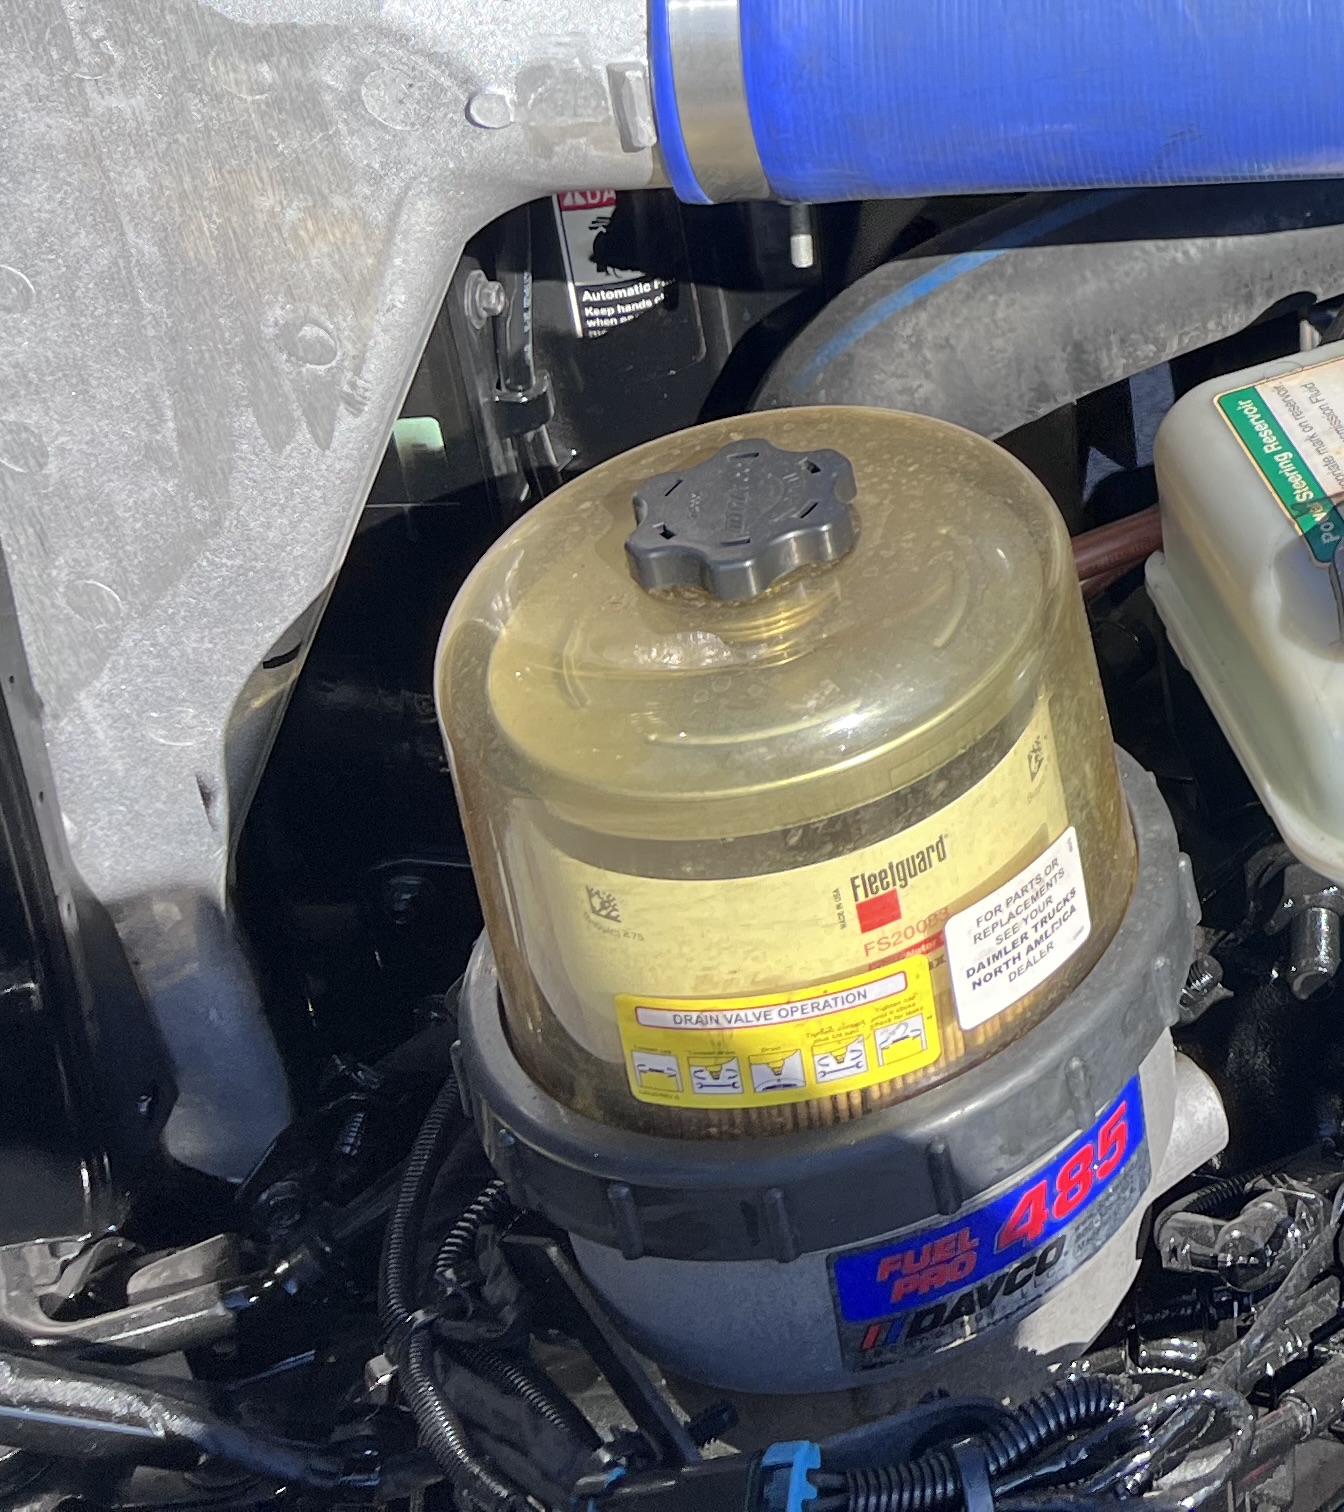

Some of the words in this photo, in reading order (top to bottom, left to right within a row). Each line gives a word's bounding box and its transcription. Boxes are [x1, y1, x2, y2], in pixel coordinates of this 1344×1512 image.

[582, 282, 651, 302] Automatic
[585, 306, 614, 317] Keep
[617, 299, 652, 313] hands
[586, 317, 617, 327] when
[1300, 382, 1325, 404] Fluid
[1237, 399, 1282, 454] Reservoir
[1299, 420, 1314, 433] on
[1304, 432, 1328, 455] mark
[1274, 452, 1314, 503] Steering
[850, 834, 947, 902] Fleetguard
[975, 904, 1003, 928] FOR
[1005, 873, 1042, 909] PARTS
[1044, 858, 1059, 876] OR
[973, 868, 1065, 944] REPLACEMENTS
[995, 924, 1020, 946] SEE
[1022, 895, 1053, 924] YOUR
[966, 931, 1029, 979] DAIMLER
[1032, 887, 1076, 933] TRUCKS
[972, 950, 1022, 991] NORTH
[1008, 940, 1055, 983] DEALER
[672, 1013, 720, 1026] DRAIN
[723, 1007, 773, 1025] VALVE
[778, 988, 868, 1019] OPERATION
[993, 1100, 1128, 1254] 485
[876, 1226, 980, 1282] FUEL
[890, 1249, 978, 1304] PRO
[904, 1235, 1066, 1339] DAVCO
